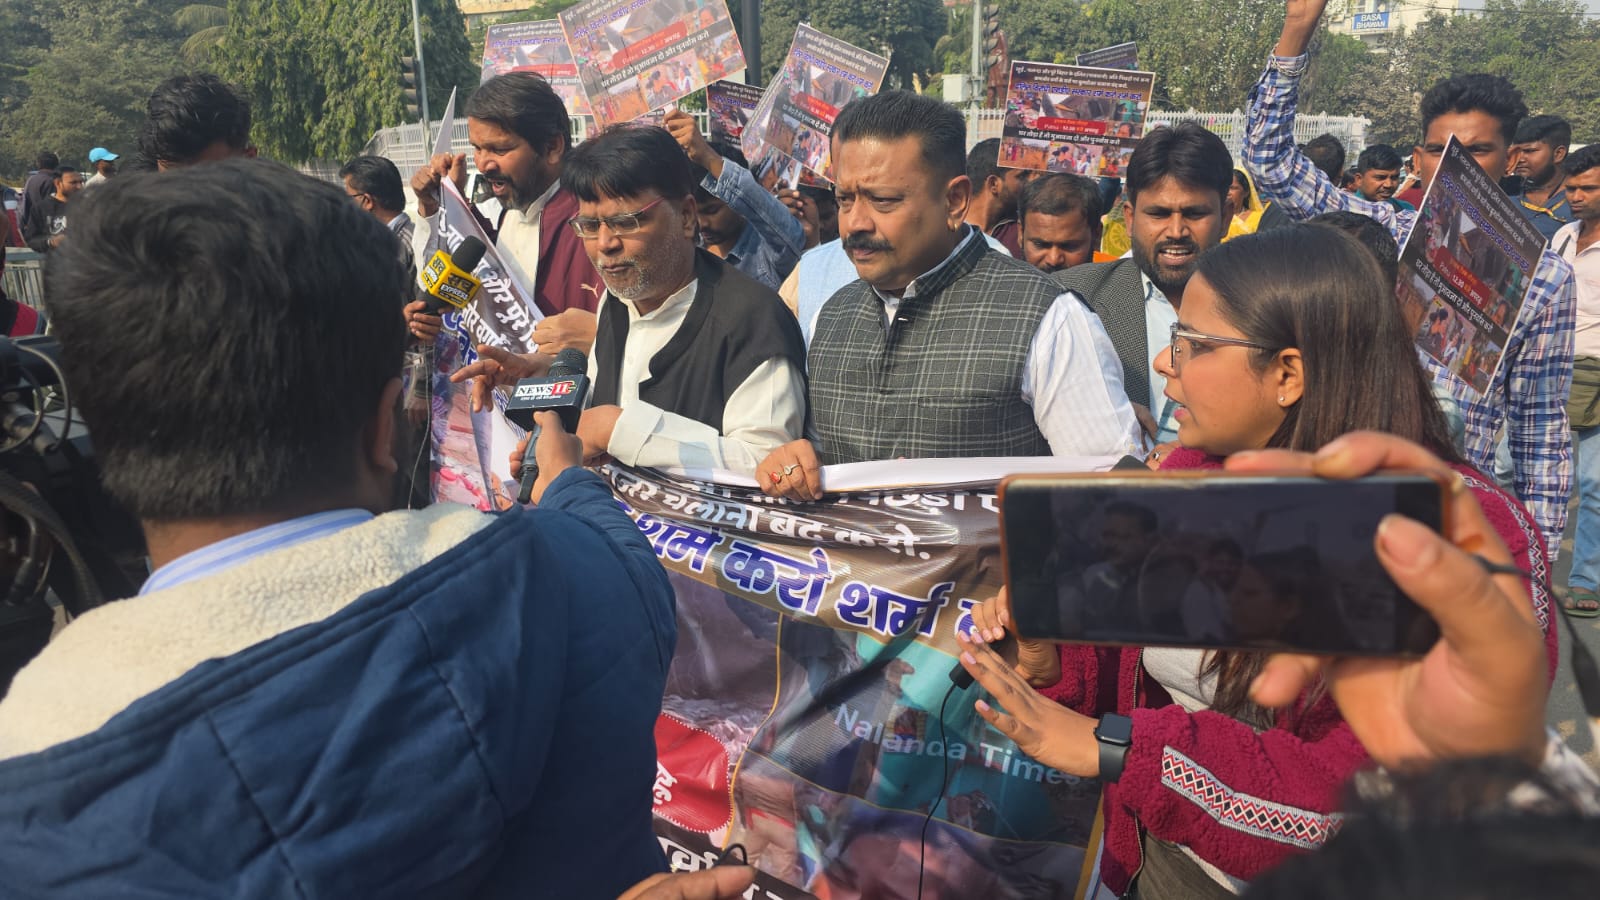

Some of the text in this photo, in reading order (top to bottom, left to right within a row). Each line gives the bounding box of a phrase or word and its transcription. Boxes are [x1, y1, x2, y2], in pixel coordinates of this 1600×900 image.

[440, 284, 469, 300] EXPRESS
[664, 486, 765, 532] चलाना
[722, 540, 834, 616] करो
[835, 580, 955, 637] शर्म
[834, 704, 1080, 785] Nalanda Times
